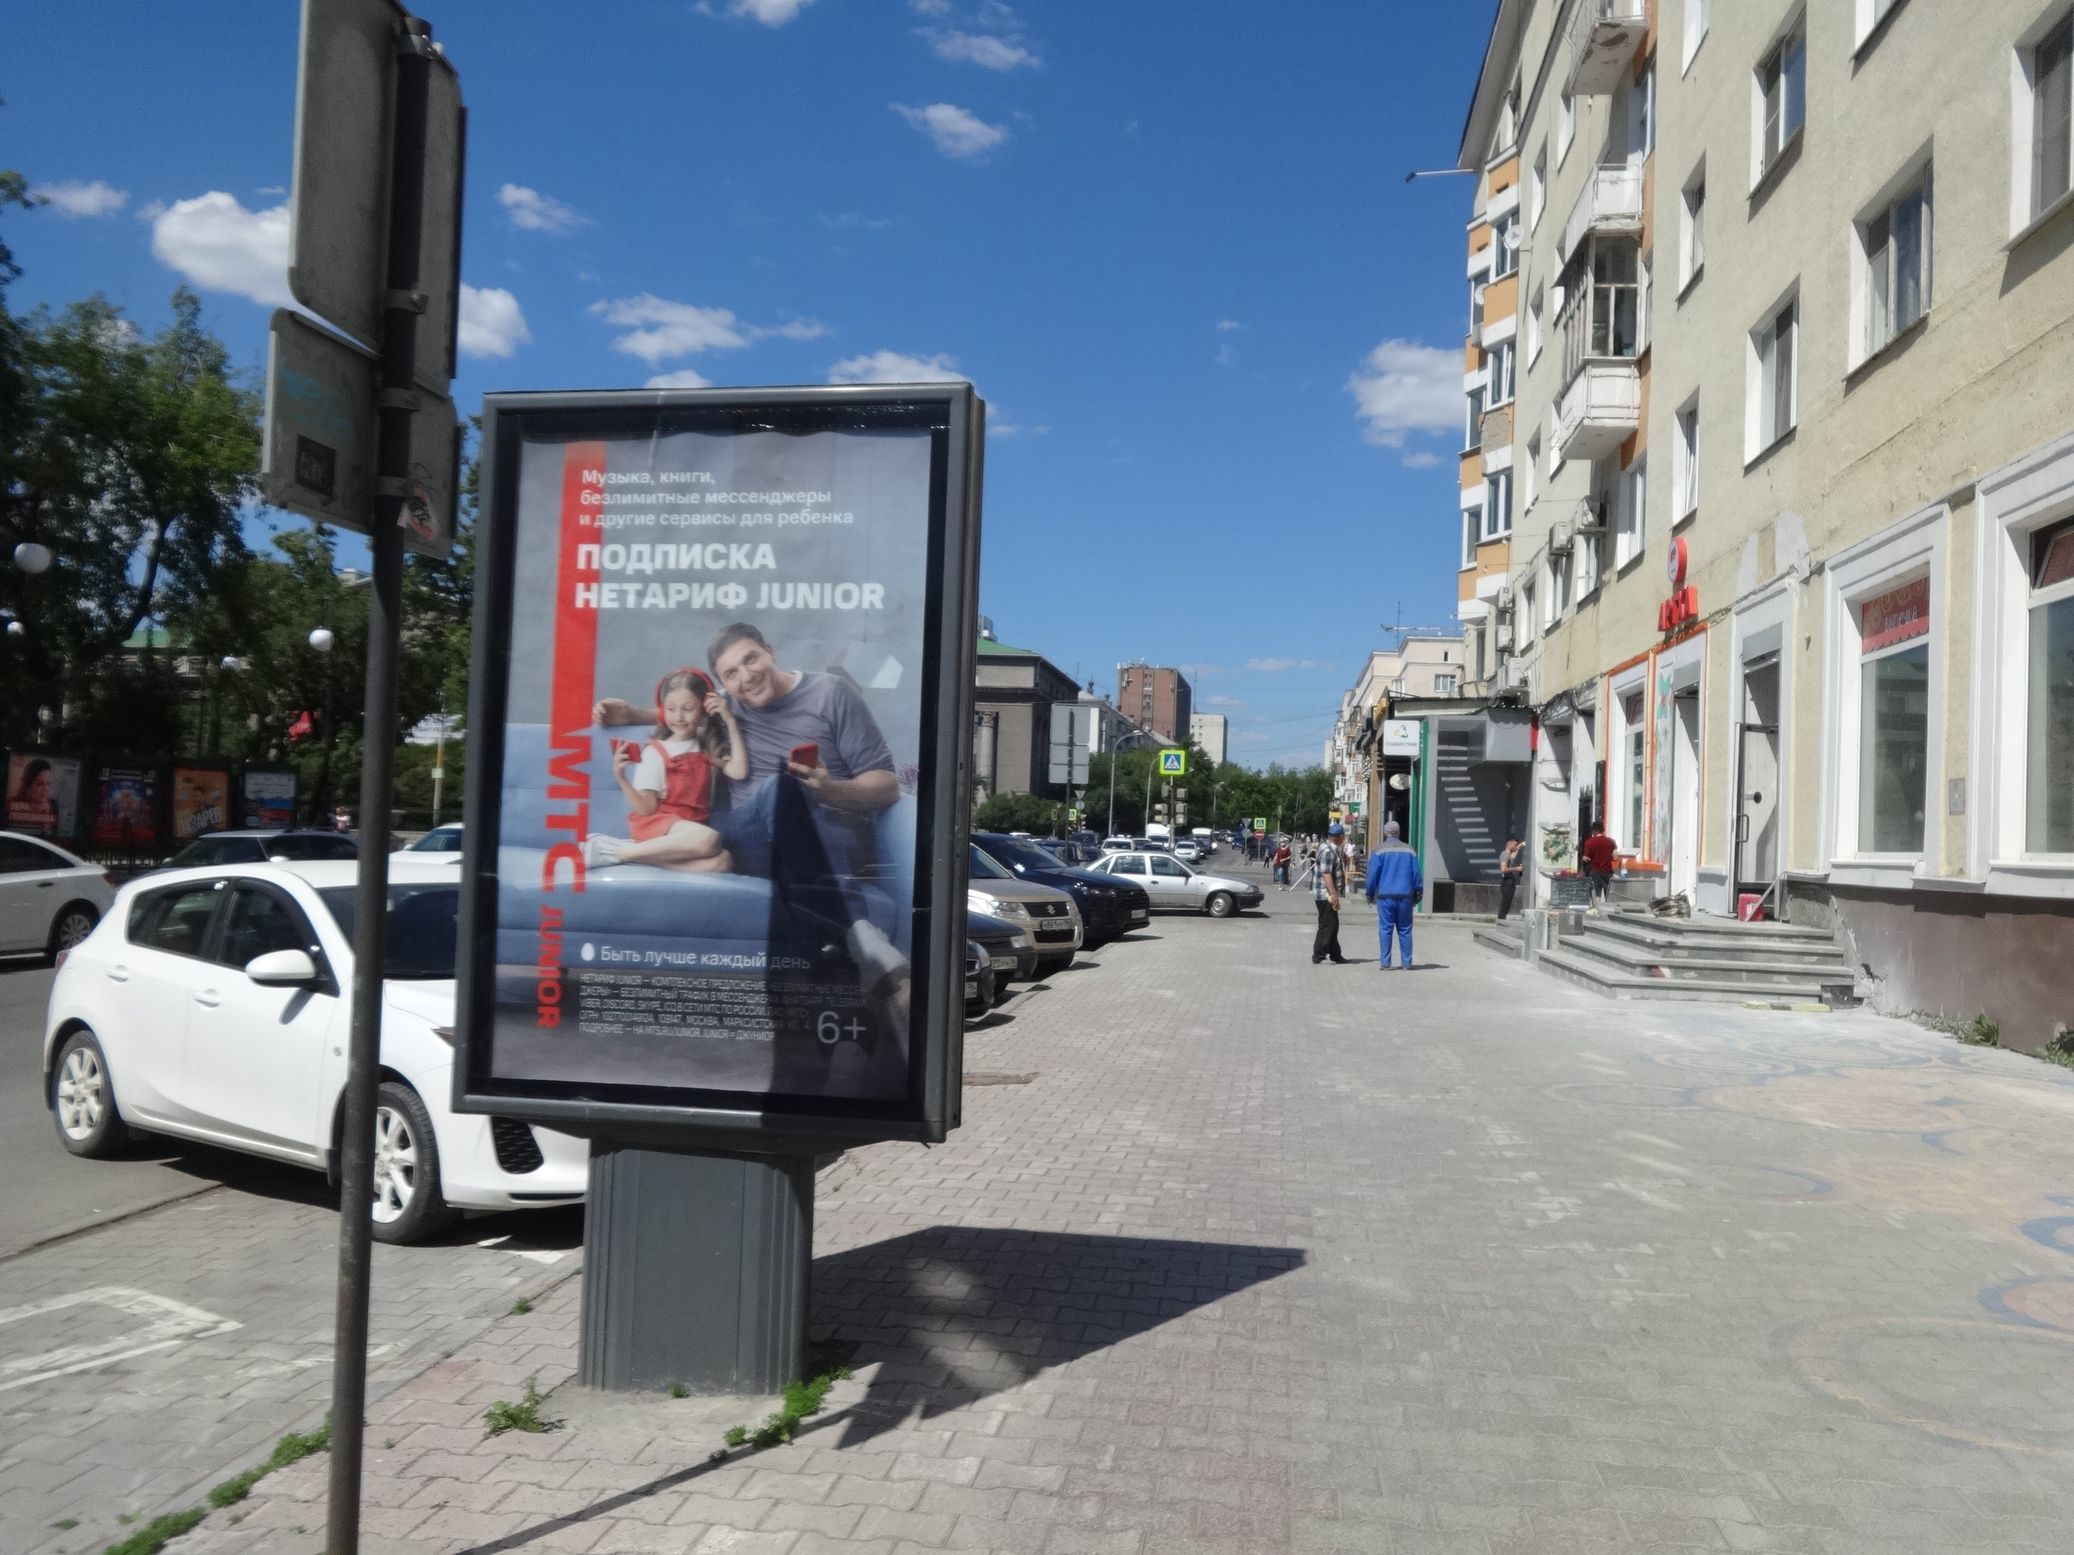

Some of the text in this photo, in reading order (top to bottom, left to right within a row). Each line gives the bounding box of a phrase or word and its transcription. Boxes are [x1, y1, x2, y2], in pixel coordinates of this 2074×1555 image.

[582, 469, 715, 487] Музыка, книги,
[580, 489, 832, 506] безлимитные мессенджеры
[579, 508, 854, 528] и другие сервисы для ребенка
[576, 543, 777, 575] ПОДПИСКА
[574, 582, 886, 609] НЕТАРИФ JUNIOR
[536, 904, 564, 1029] JUNIOR
[601, 946, 811, 970] Быть лучше каждый день
[816, 1010, 867, 1044] 6+
